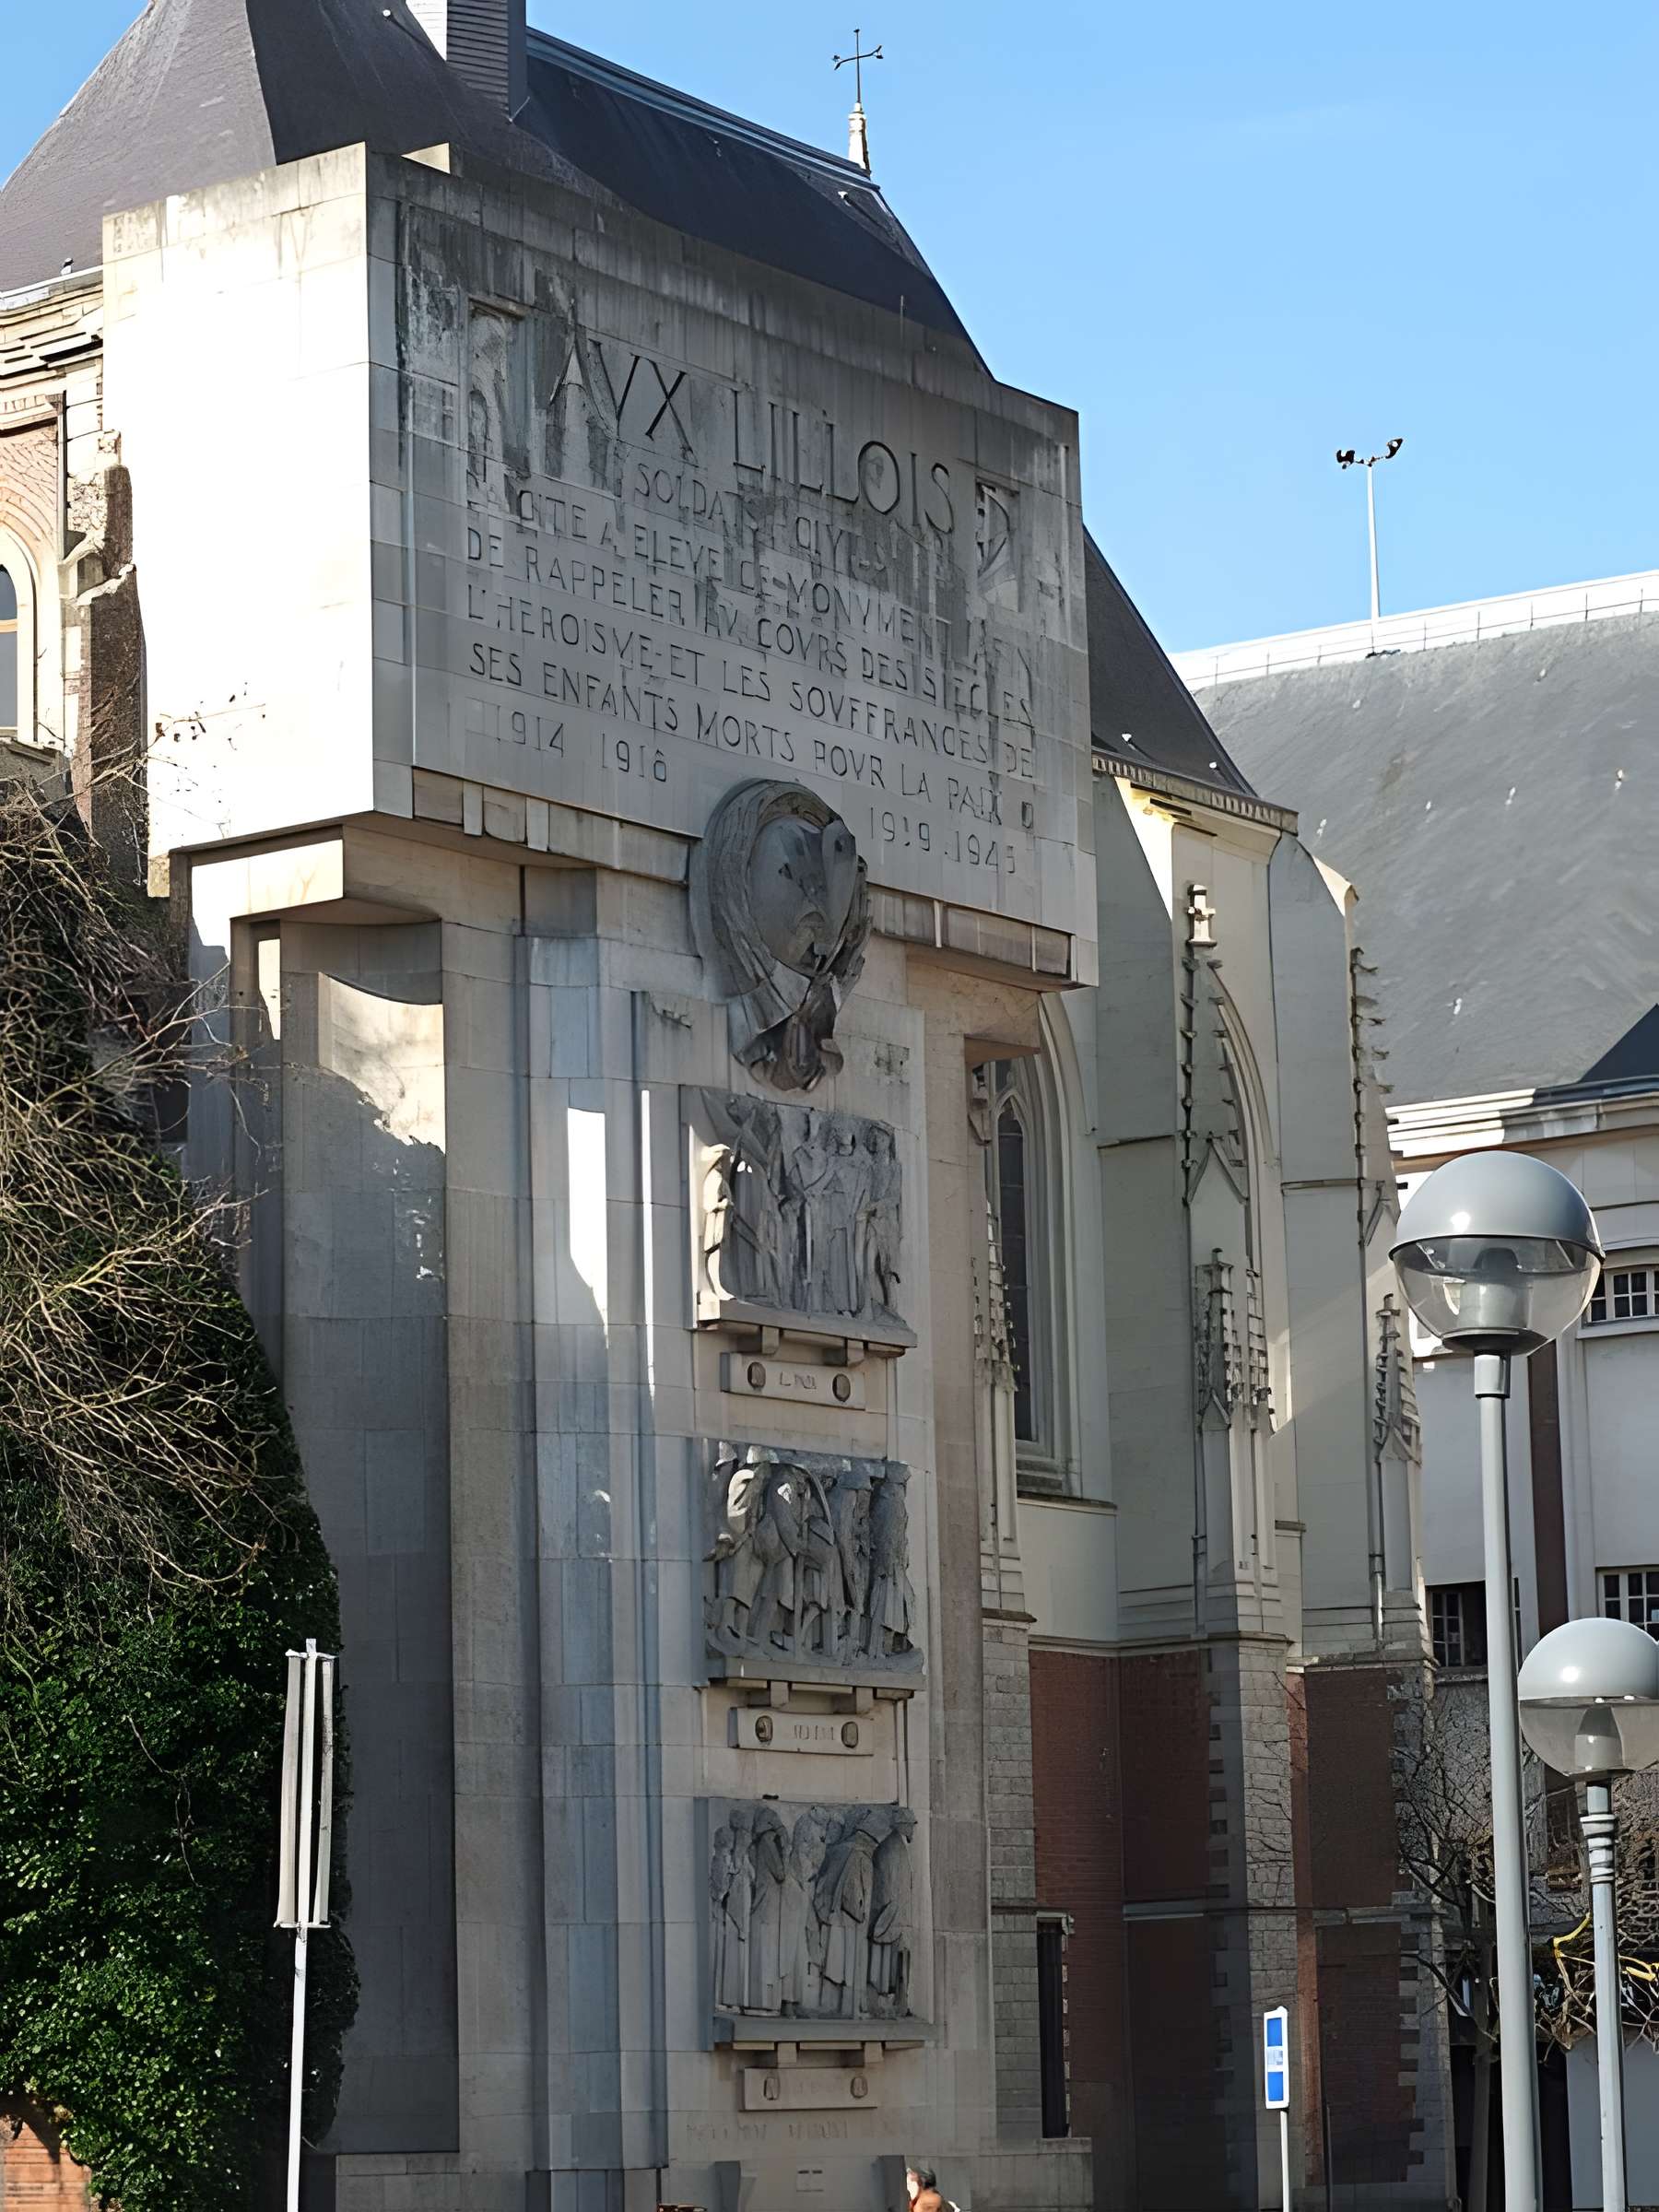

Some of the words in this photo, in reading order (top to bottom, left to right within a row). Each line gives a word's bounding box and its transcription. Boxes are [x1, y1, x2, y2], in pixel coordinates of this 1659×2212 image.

[467, 527, 504, 568] DE
[525, 545, 685, 626] RAPPELER
[759, 618, 848, 673] COVRS
[861, 646, 908, 691] DES
[469, 642, 522, 686] SES
[542, 662, 678, 731] ENFANTS
[697, 701, 794, 762] MORTS
[813, 739, 886, 790] POVR
[901, 762, 932, 804] LA
[493, 703, 564, 758] 1914
[670, 644, 706, 686] ET
[724, 660, 771, 701] LES
[789, 681, 989, 764] SOVFFRANCES
[1003, 741, 1034, 779] DE
